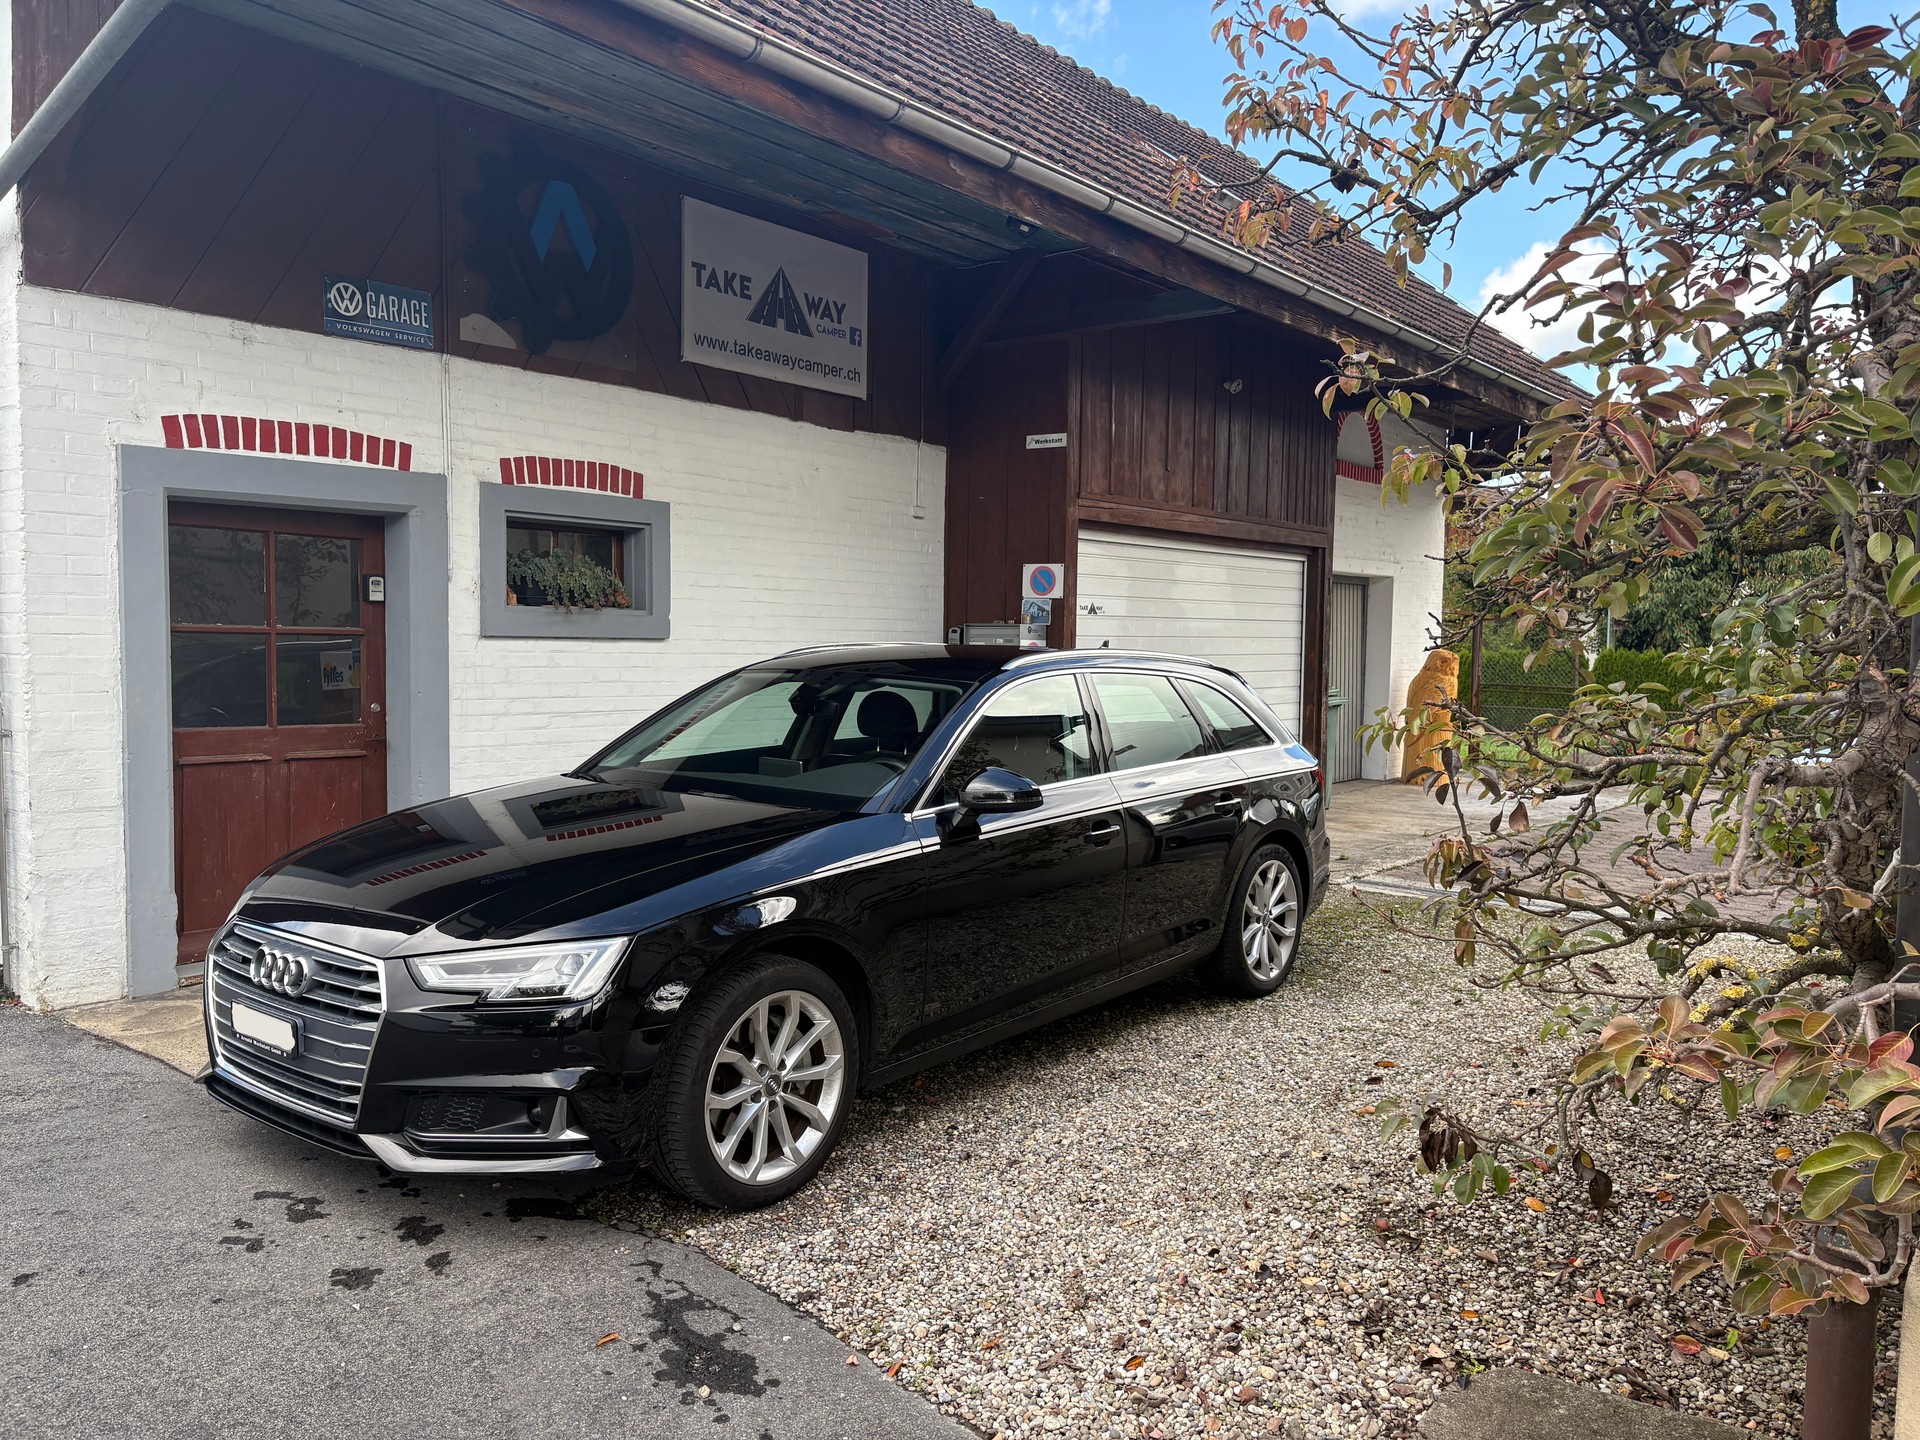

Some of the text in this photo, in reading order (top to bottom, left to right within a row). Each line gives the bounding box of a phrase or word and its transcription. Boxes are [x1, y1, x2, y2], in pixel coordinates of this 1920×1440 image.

[691, 261, 752, 300] TAKE
[366, 291, 429, 328] GARAGE
[336, 323, 425, 344] VOLKSWAGEN SERVICE
[816, 323, 847, 340] CAMPER
[694, 332, 861, 383] www.takeawaycamper.ch
[1034, 437, 1063, 445] Werkstatt
